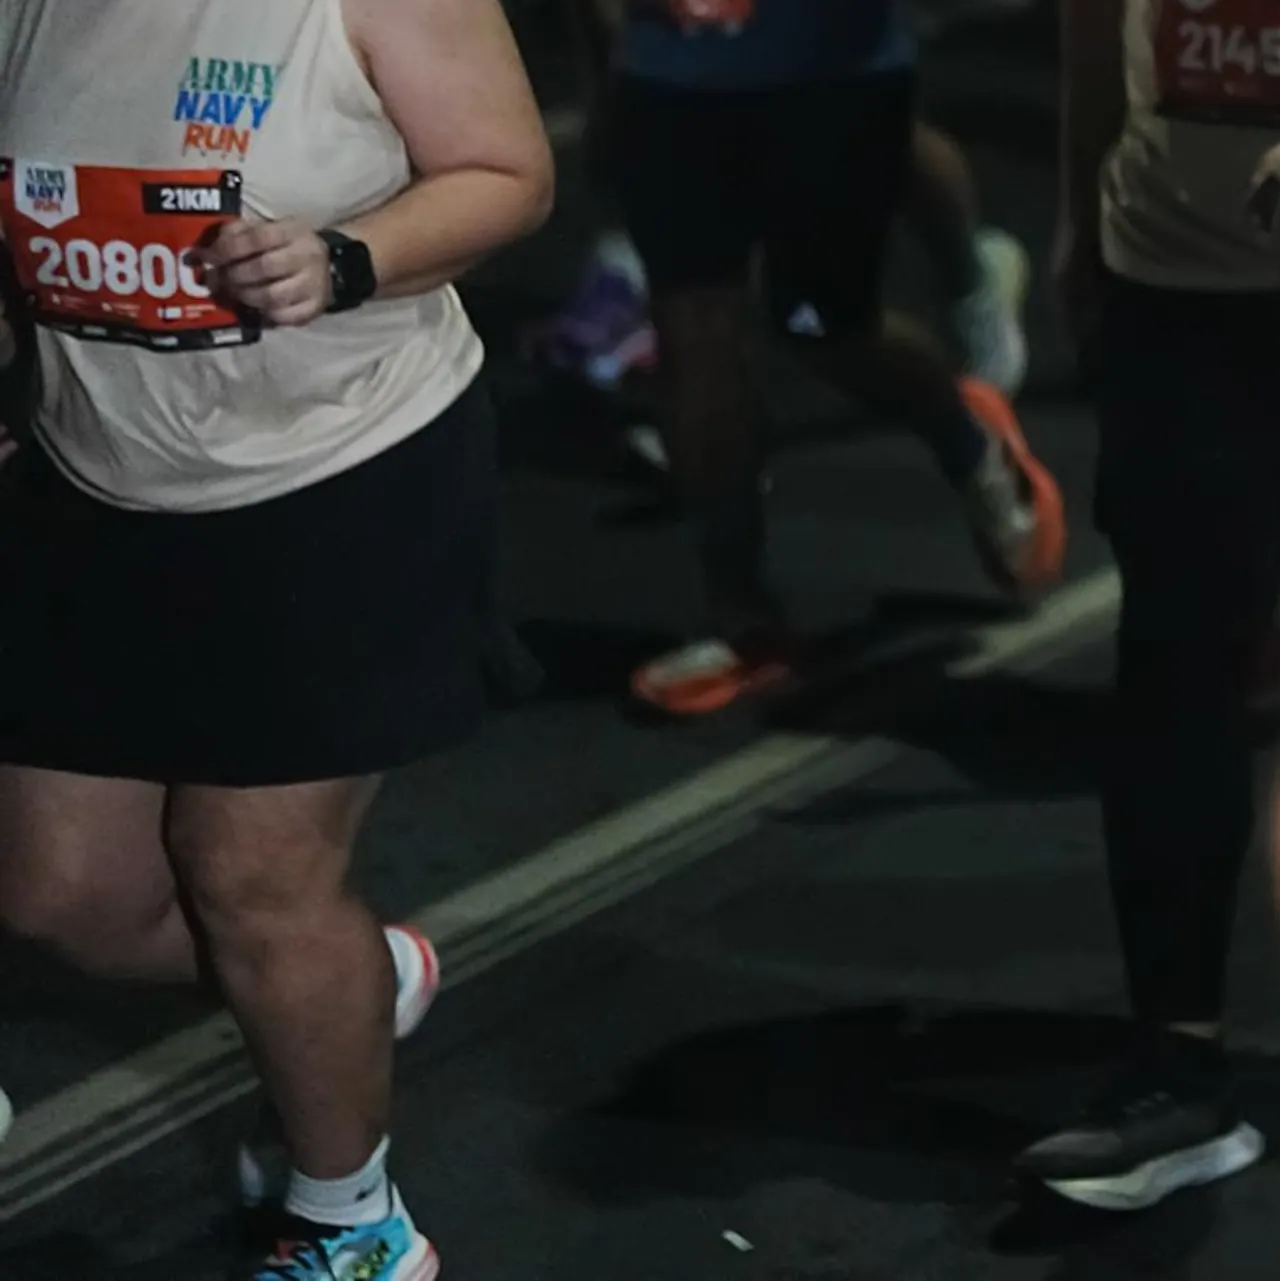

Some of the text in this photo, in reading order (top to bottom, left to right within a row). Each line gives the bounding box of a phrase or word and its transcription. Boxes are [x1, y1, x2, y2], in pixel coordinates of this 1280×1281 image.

[180, 57, 273, 97] ARMY
[174, 89, 272, 131] NAVY
[182, 122, 250, 156] RUN
[160, 187, 221, 212] 21KM
